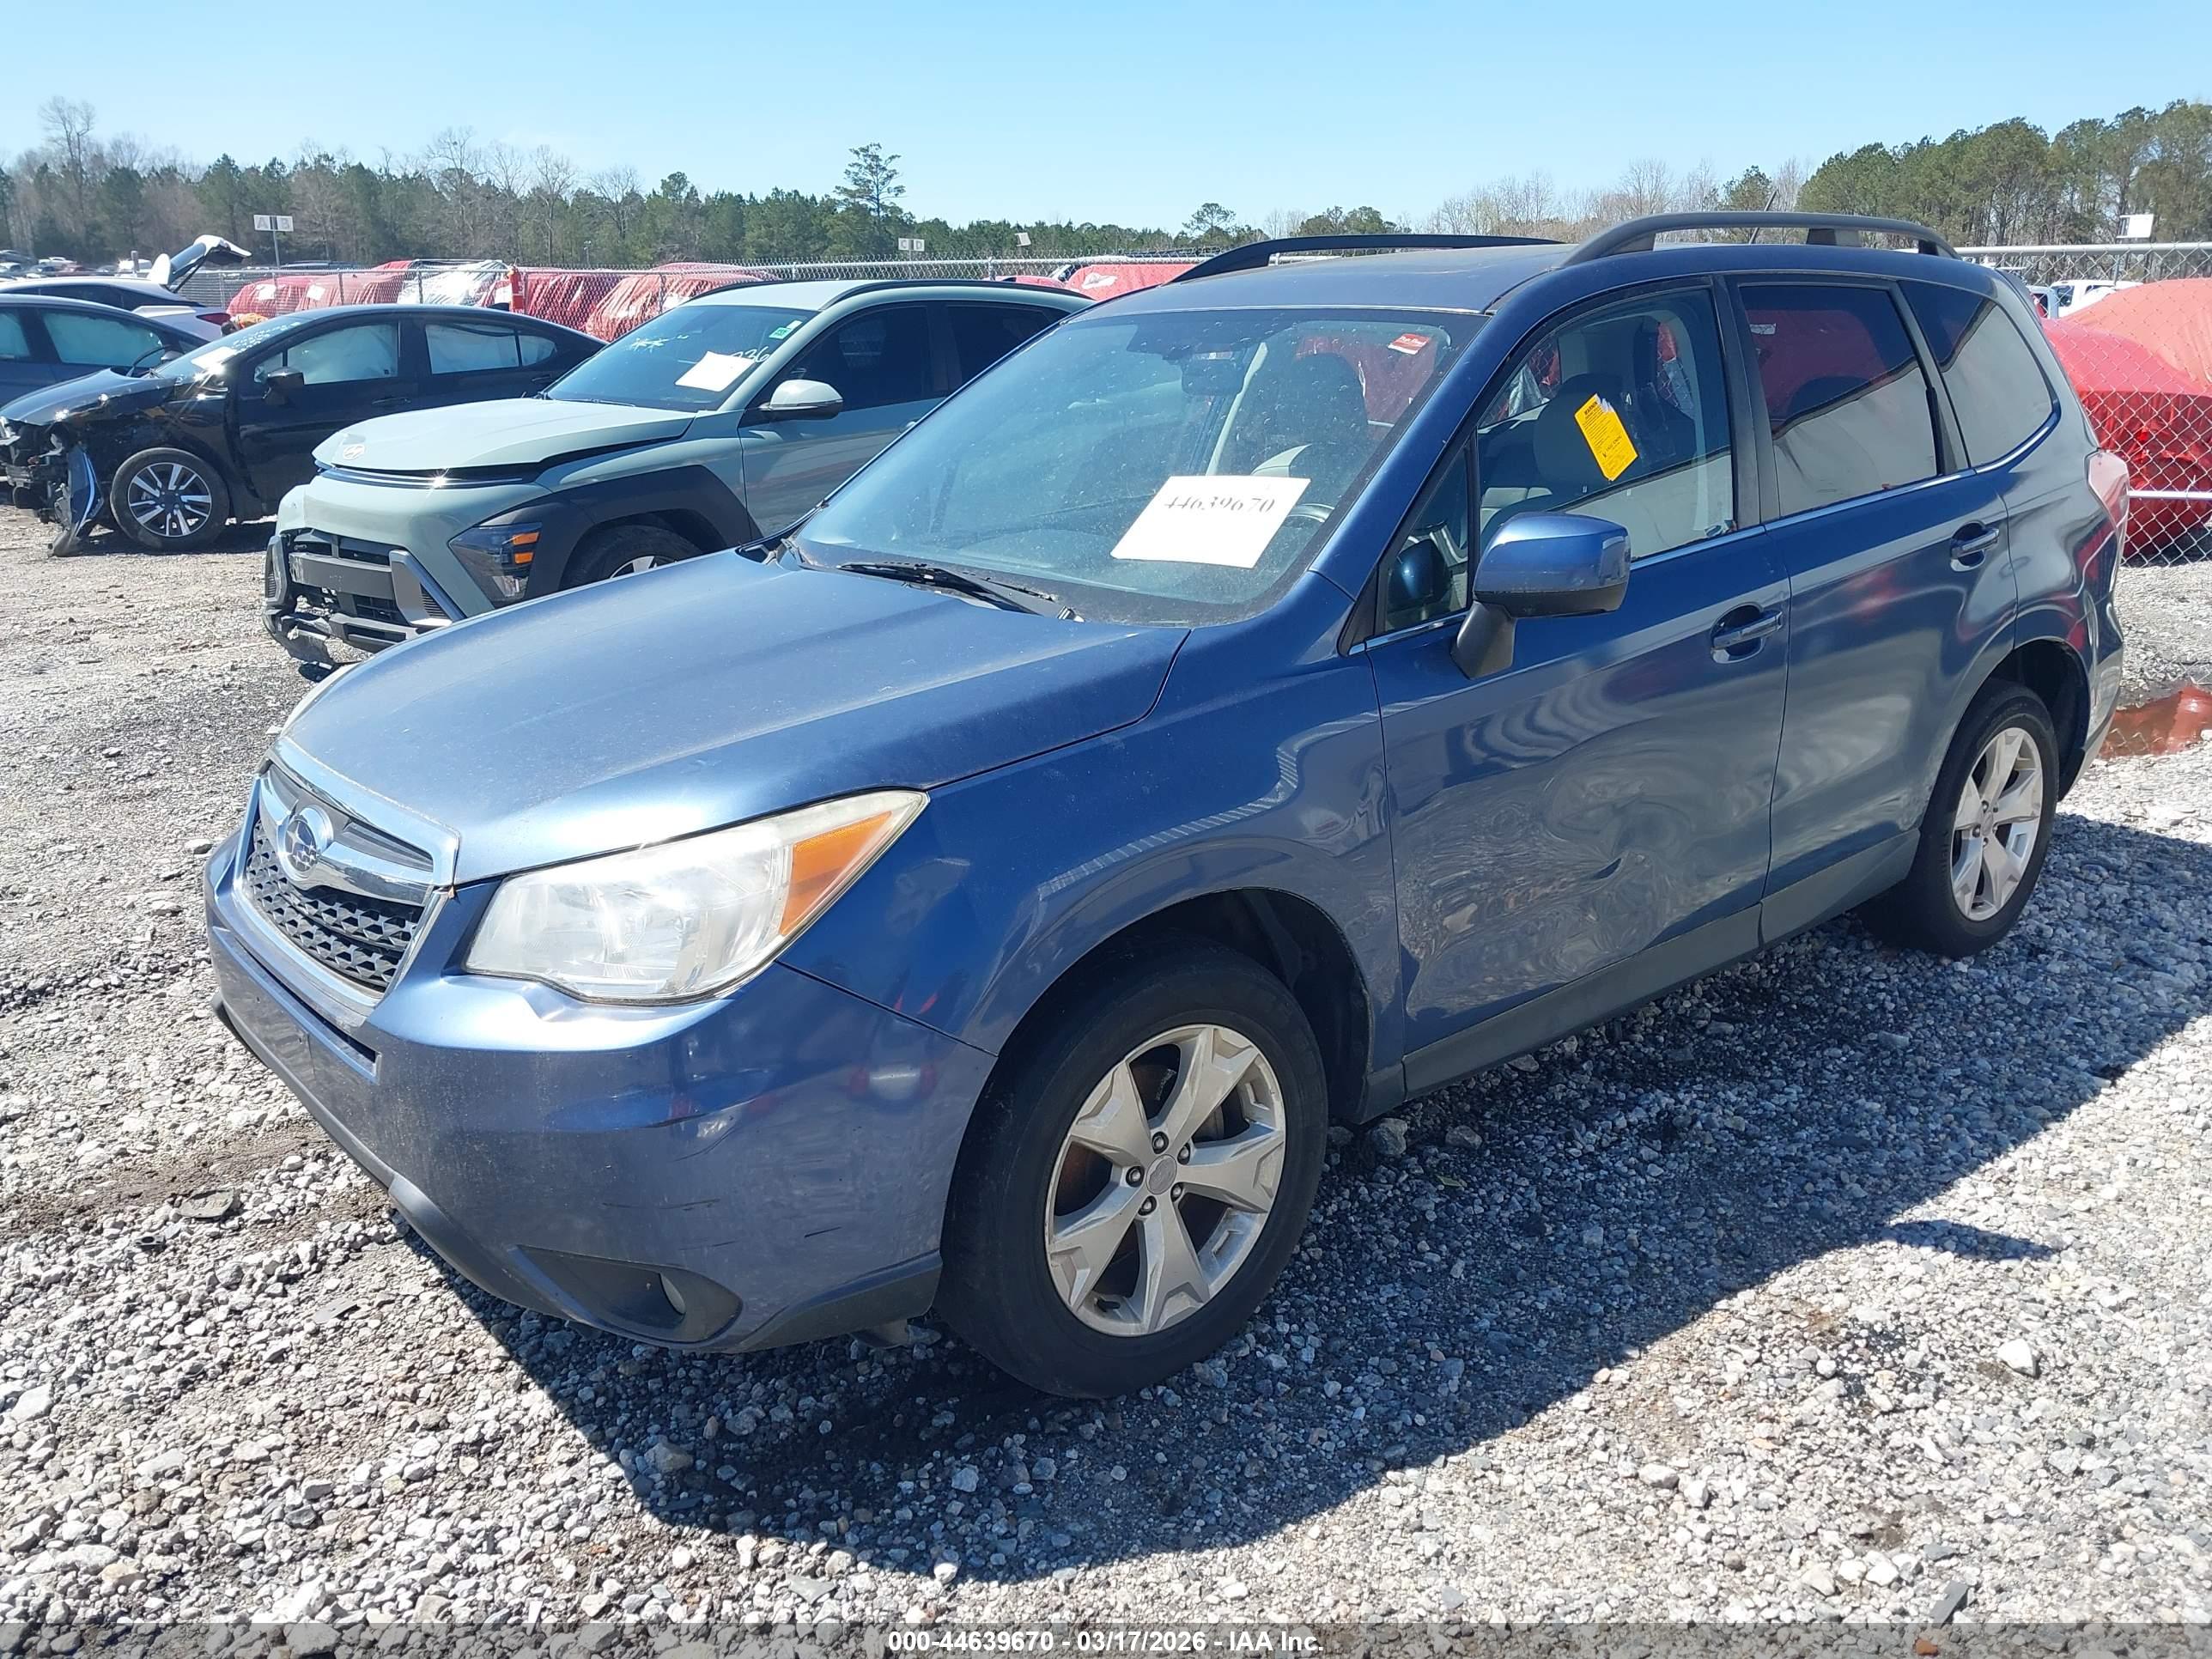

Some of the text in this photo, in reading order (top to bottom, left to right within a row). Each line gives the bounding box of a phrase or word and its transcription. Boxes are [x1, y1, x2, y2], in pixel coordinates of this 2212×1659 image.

[257, 216, 290, 230] A B
[900, 239, 923, 250] C D
